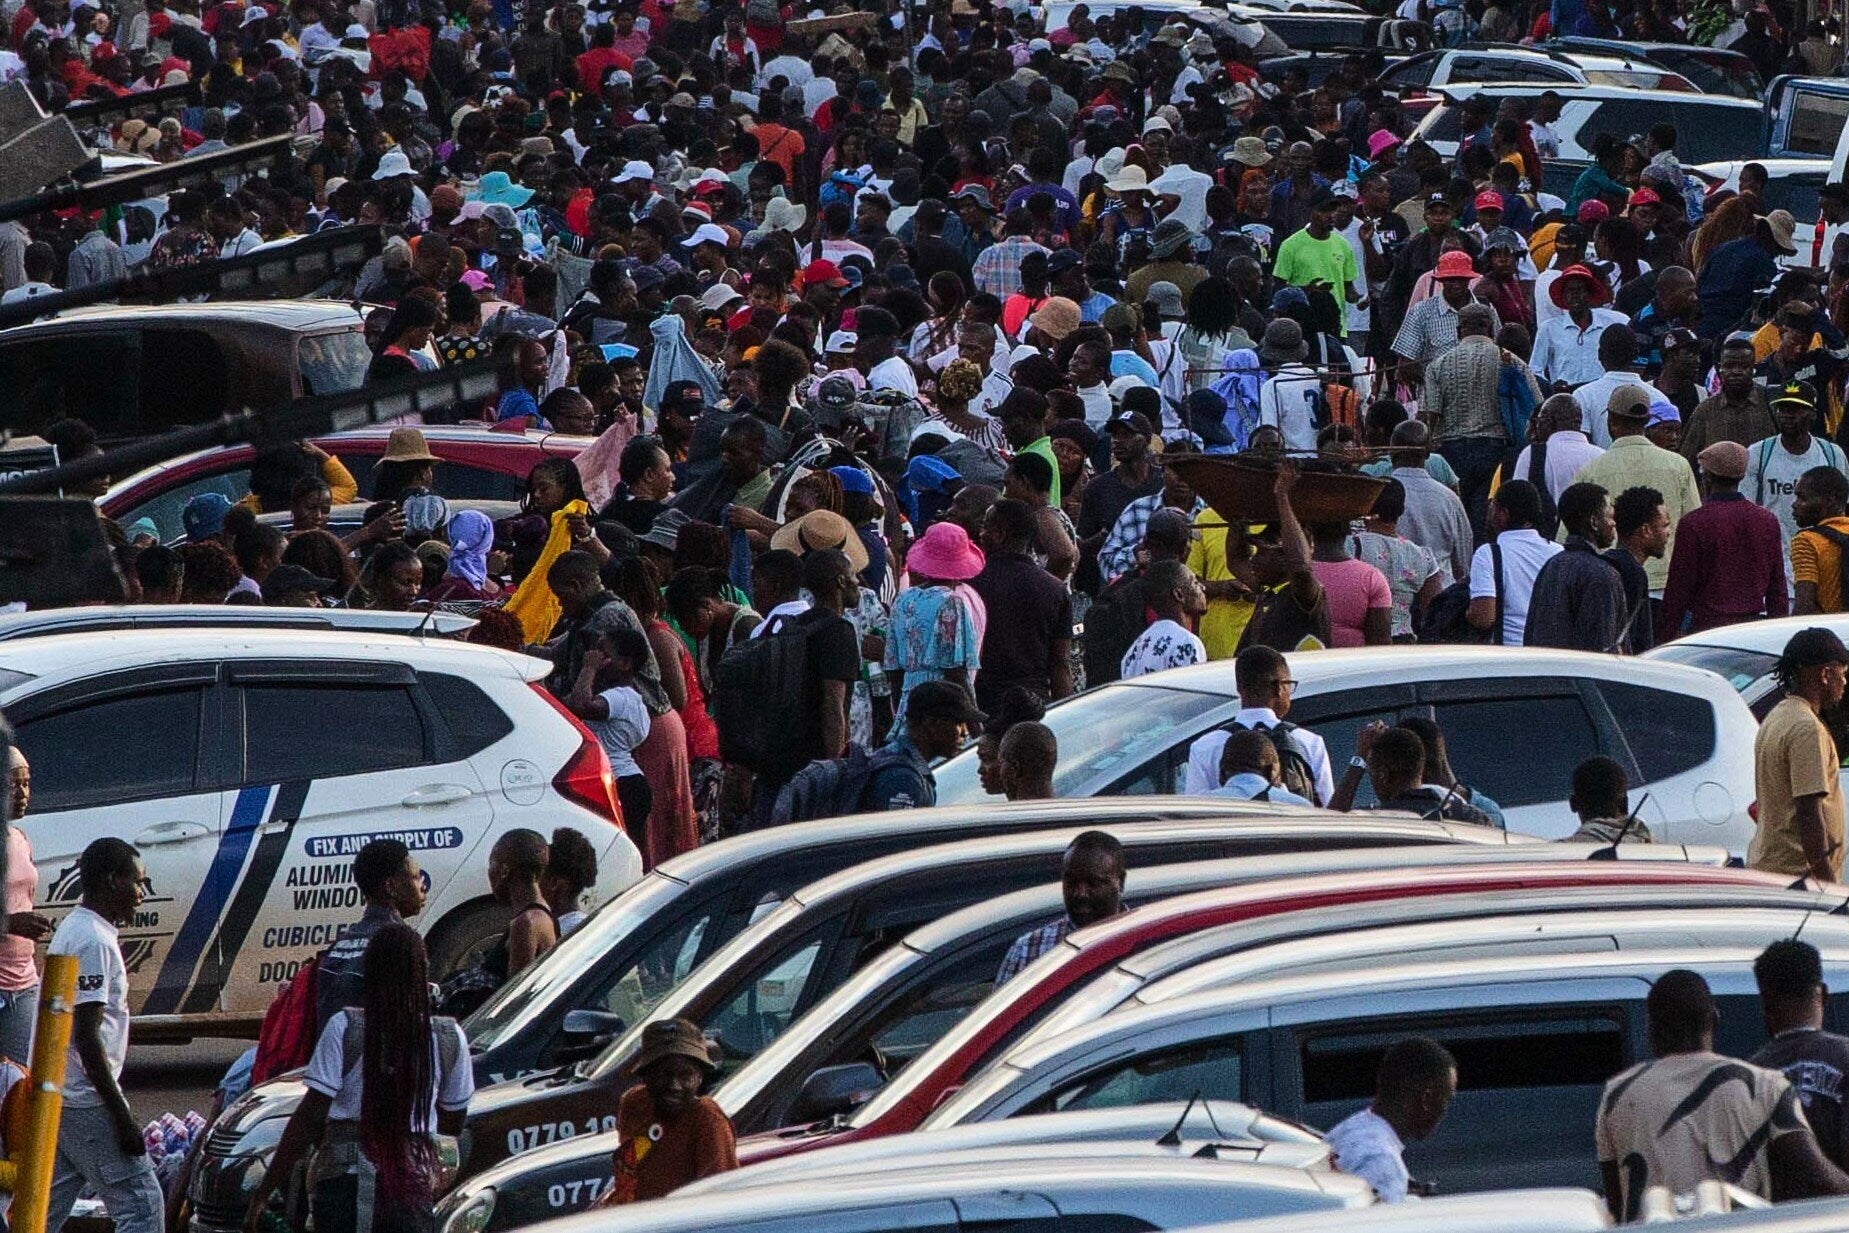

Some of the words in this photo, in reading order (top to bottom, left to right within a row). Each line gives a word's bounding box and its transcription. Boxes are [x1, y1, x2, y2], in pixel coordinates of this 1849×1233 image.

[313, 837, 339, 855] FIX
[434, 829, 453, 847] OF
[294, 887, 367, 910] WINDO
